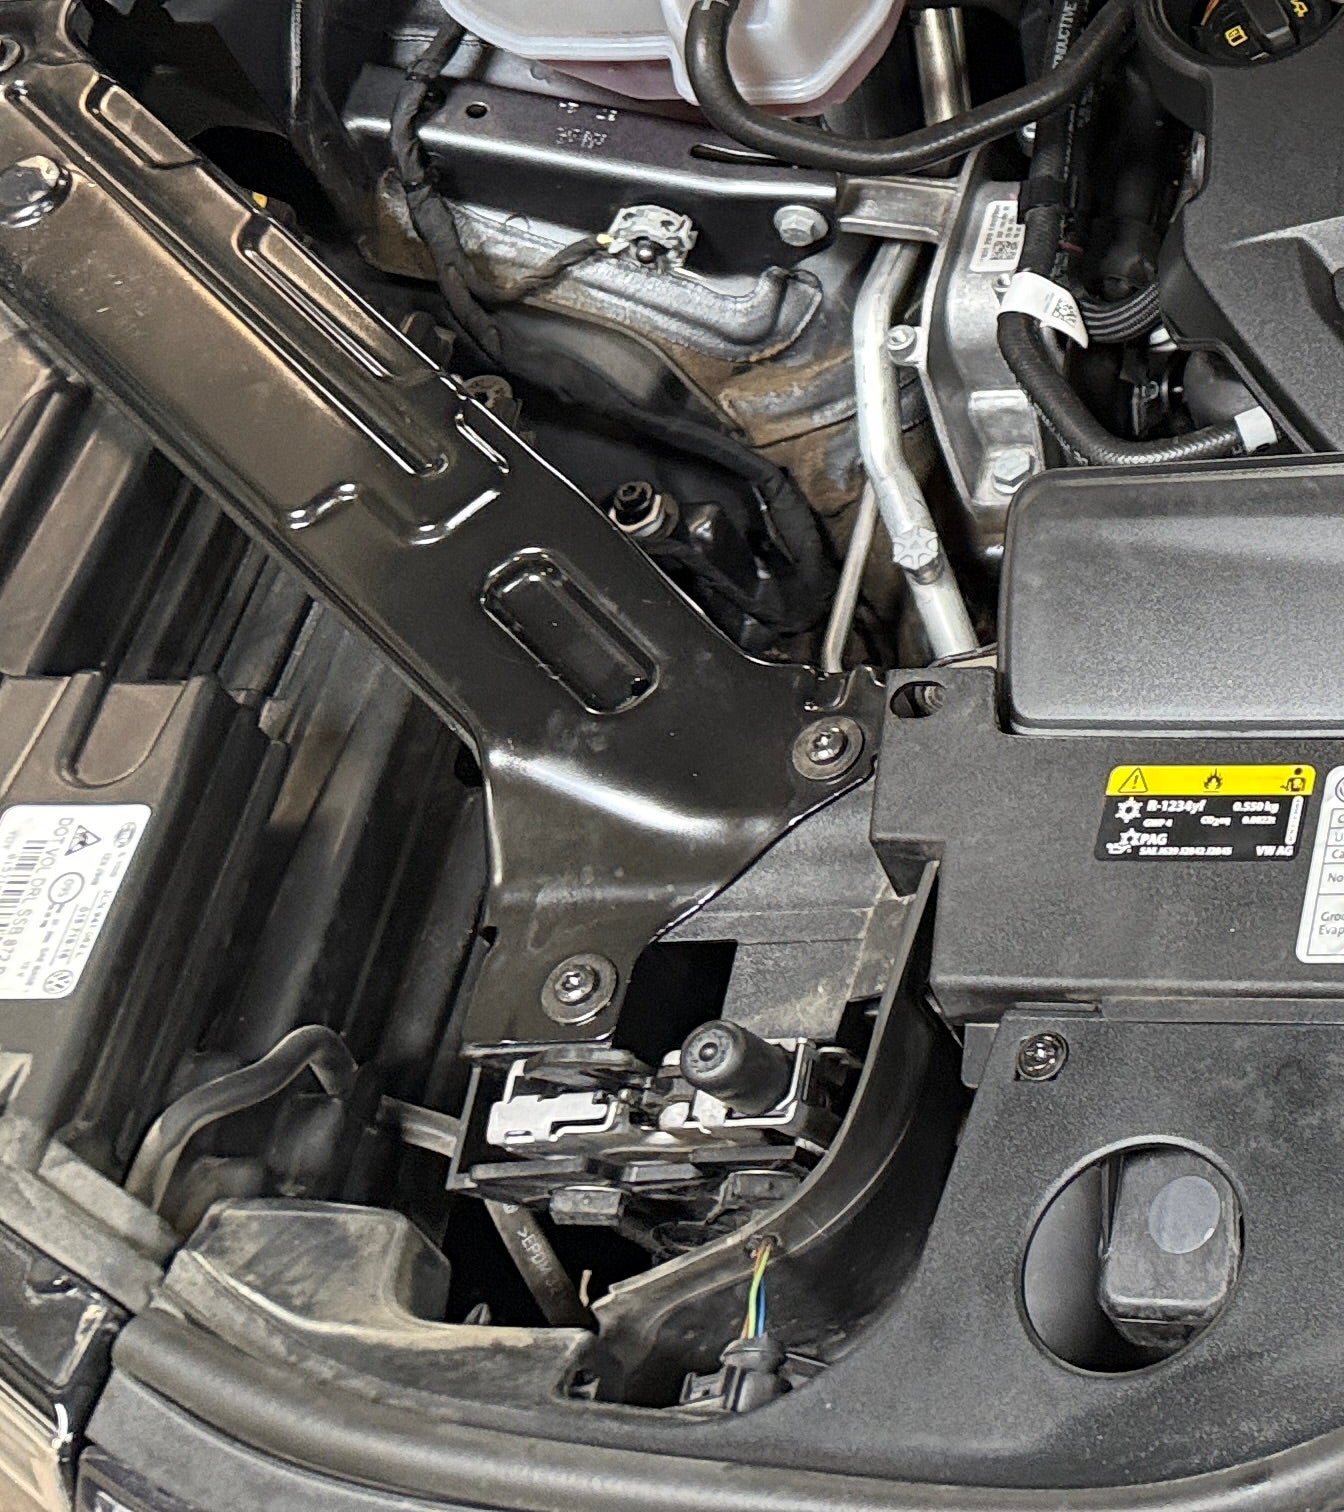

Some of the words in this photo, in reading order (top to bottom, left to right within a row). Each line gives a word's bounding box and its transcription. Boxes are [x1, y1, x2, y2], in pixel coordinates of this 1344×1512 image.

[1146, 799, 1208, 814] R-1234yf
[1232, 801, 1264, 812] 0.550
[1264, 801, 1280, 813] kg
[53, 817, 74, 844] DOT
[1140, 832, 1168, 845] PAG
[1255, 845, 1277, 856] VW
[1276, 845, 1294, 856] AG
[36, 848, 60, 873] VOL
[1327, 872, 1344, 882] No
[21, 878, 46, 903] DRL
